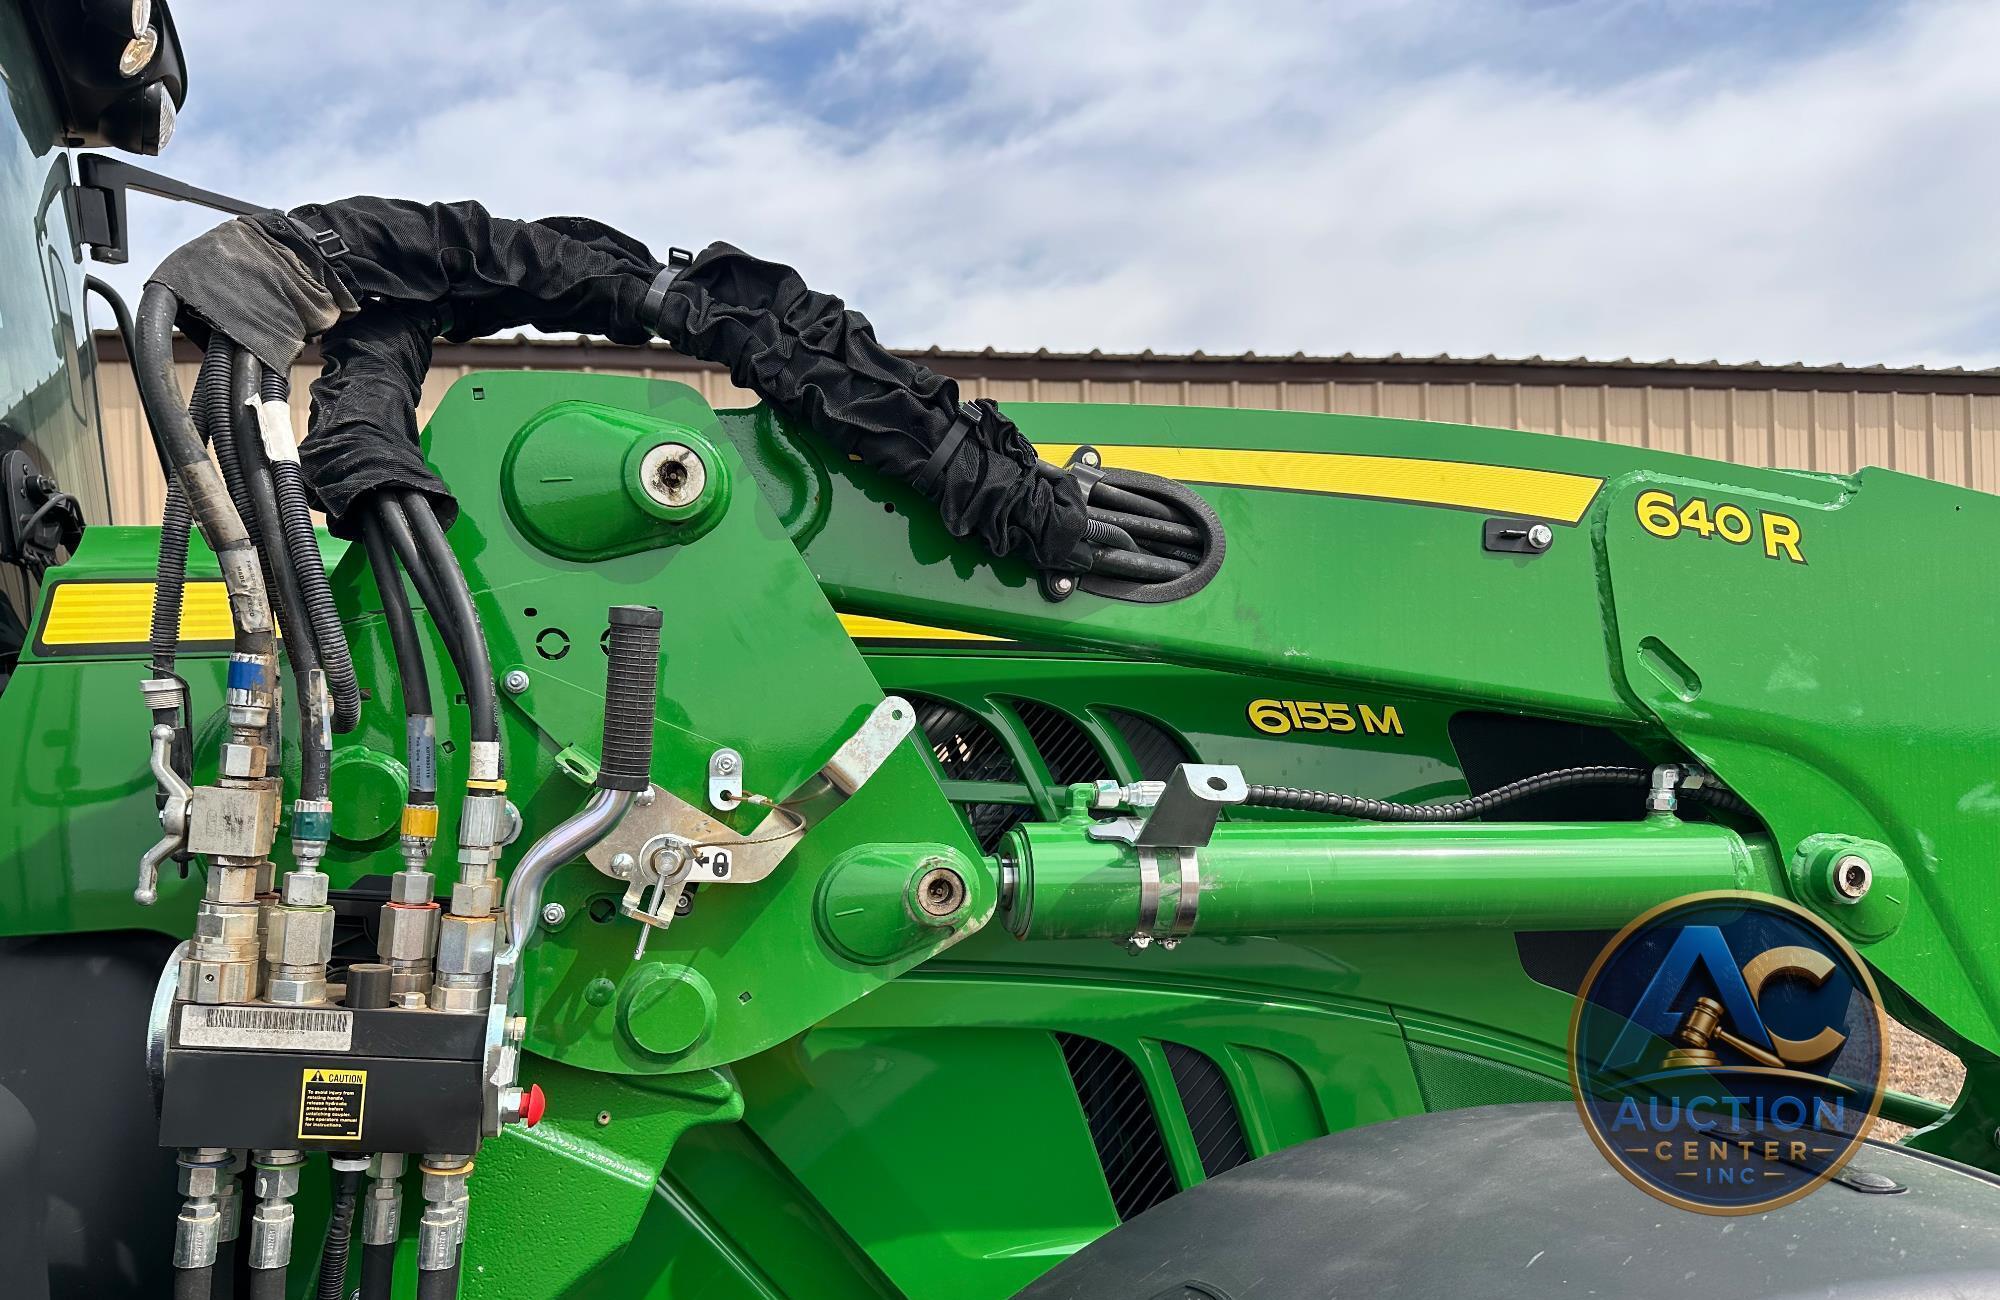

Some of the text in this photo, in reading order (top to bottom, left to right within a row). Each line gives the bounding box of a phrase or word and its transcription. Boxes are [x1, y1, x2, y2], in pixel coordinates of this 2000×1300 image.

[1635, 489, 1808, 565] 640 R
[1246, 698, 1404, 736] 6155 M
[328, 1074, 362, 1083] CAUTION
